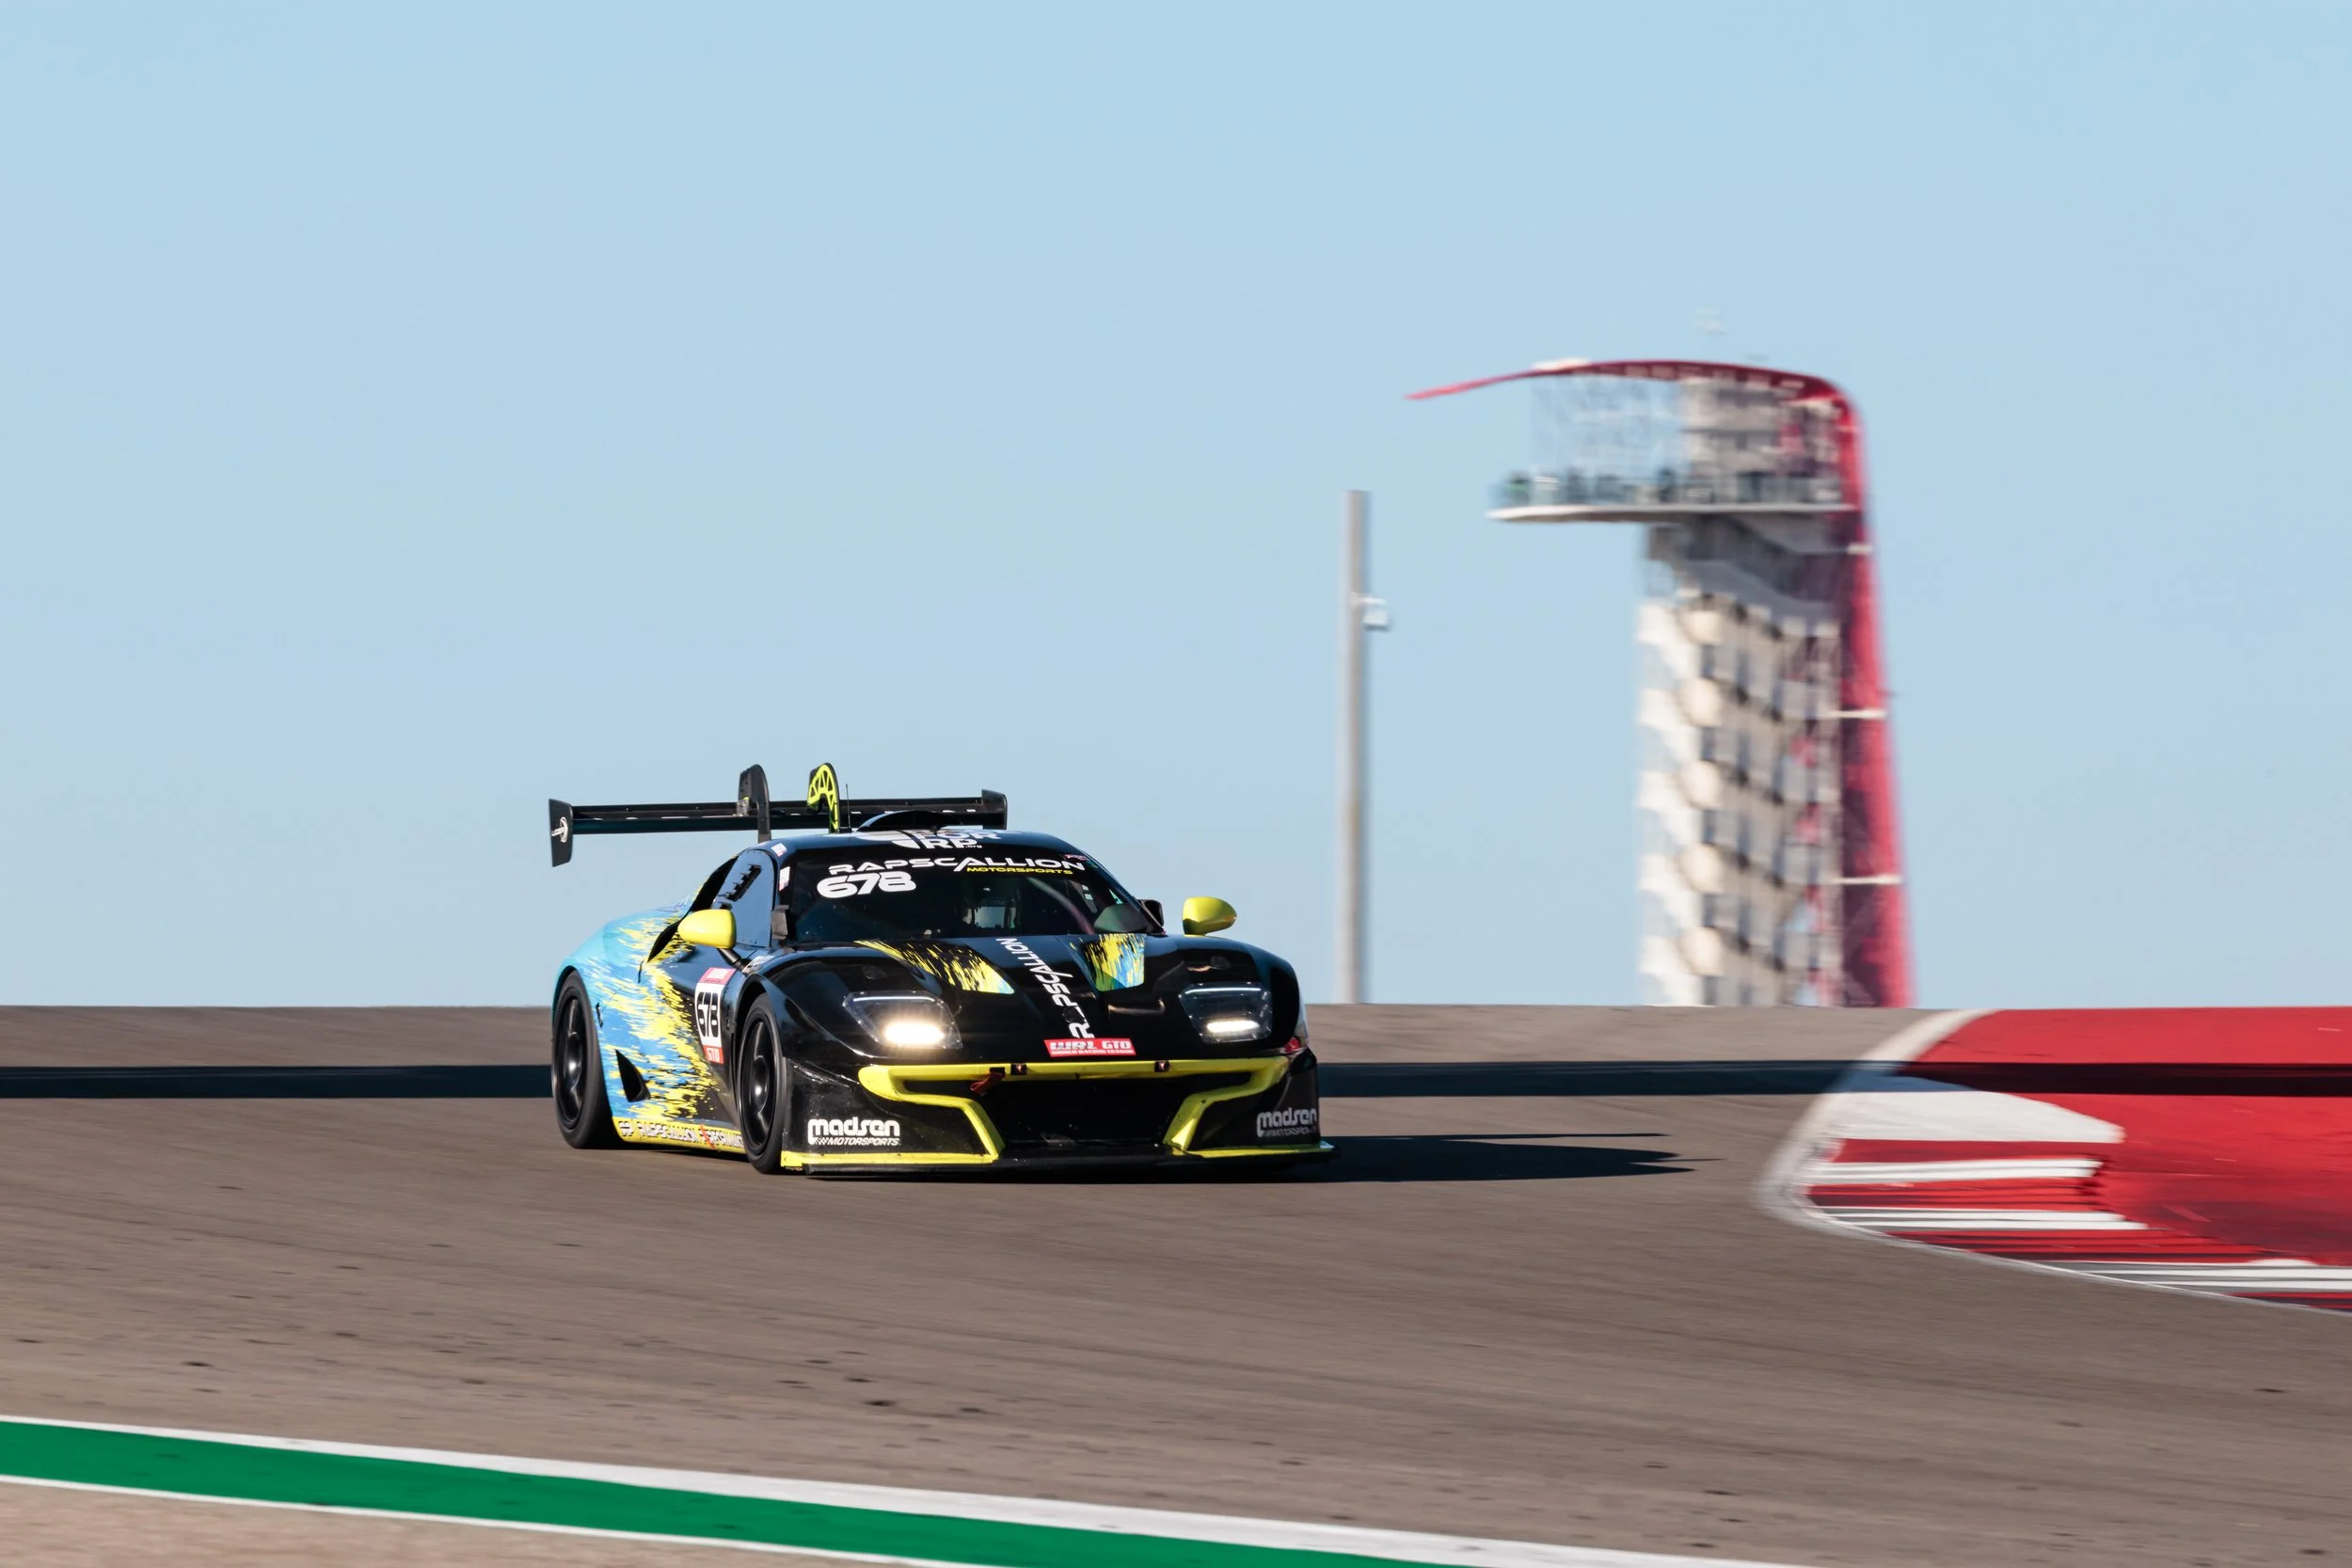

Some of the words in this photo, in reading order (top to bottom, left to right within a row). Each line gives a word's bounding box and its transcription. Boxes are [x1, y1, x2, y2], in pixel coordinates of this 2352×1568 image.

[829, 857, 1085, 875] RAPSCALLION
[817, 871, 916, 898] 678
[697, 992, 719, 1038] 678
[707, 1048, 721, 1062] GTO
[1049, 1041, 1098, 1050] WRL
[1102, 1040, 1132, 1050] GTO
[807, 1117, 900, 1145] madsen
[1256, 1107, 1317, 1137] madsen
[828, 1136, 900, 1146] MOTORSPORTS
